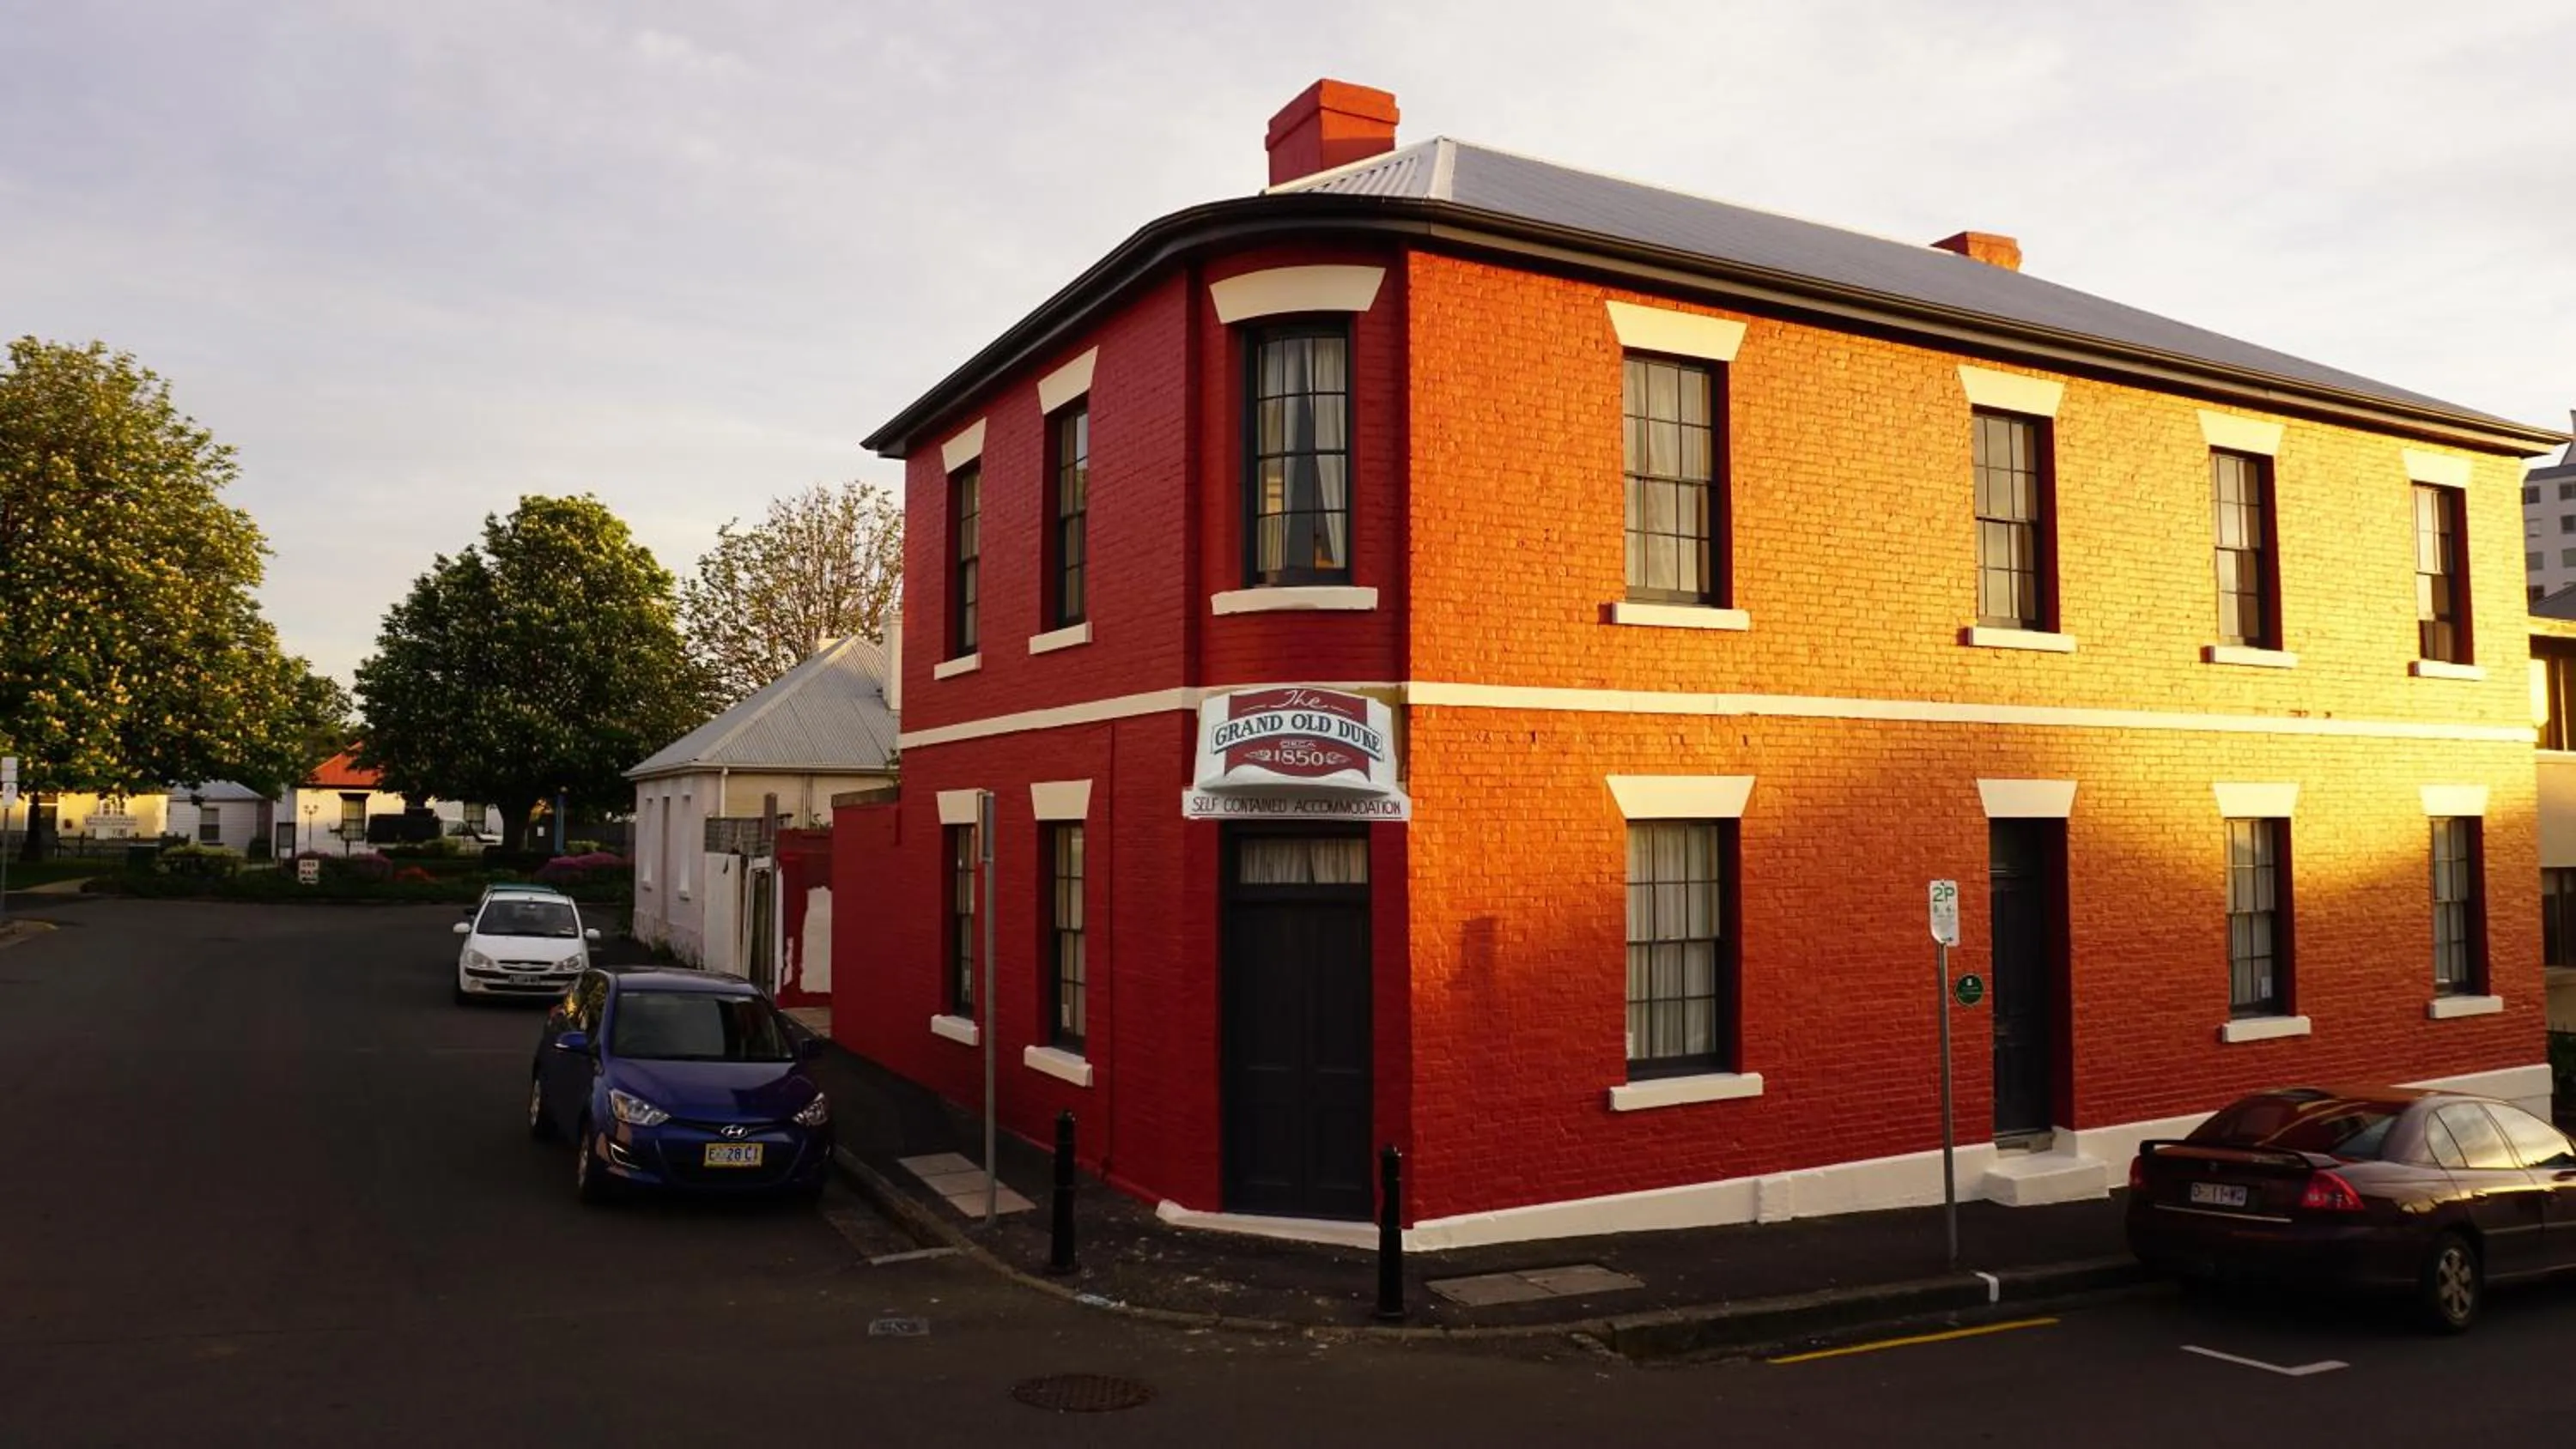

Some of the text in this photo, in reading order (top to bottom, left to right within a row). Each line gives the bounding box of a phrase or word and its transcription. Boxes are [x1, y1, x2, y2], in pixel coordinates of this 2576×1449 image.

[1270, 689, 1327, 709] The
[1215, 713, 1381, 753] GRAND OLD DUKE
[1274, 749, 1323, 767] 1850
[1192, 796, 1401, 815] SELF CONTAINED ACCOMMODATION
[1933, 886, 1955, 902] 2P
